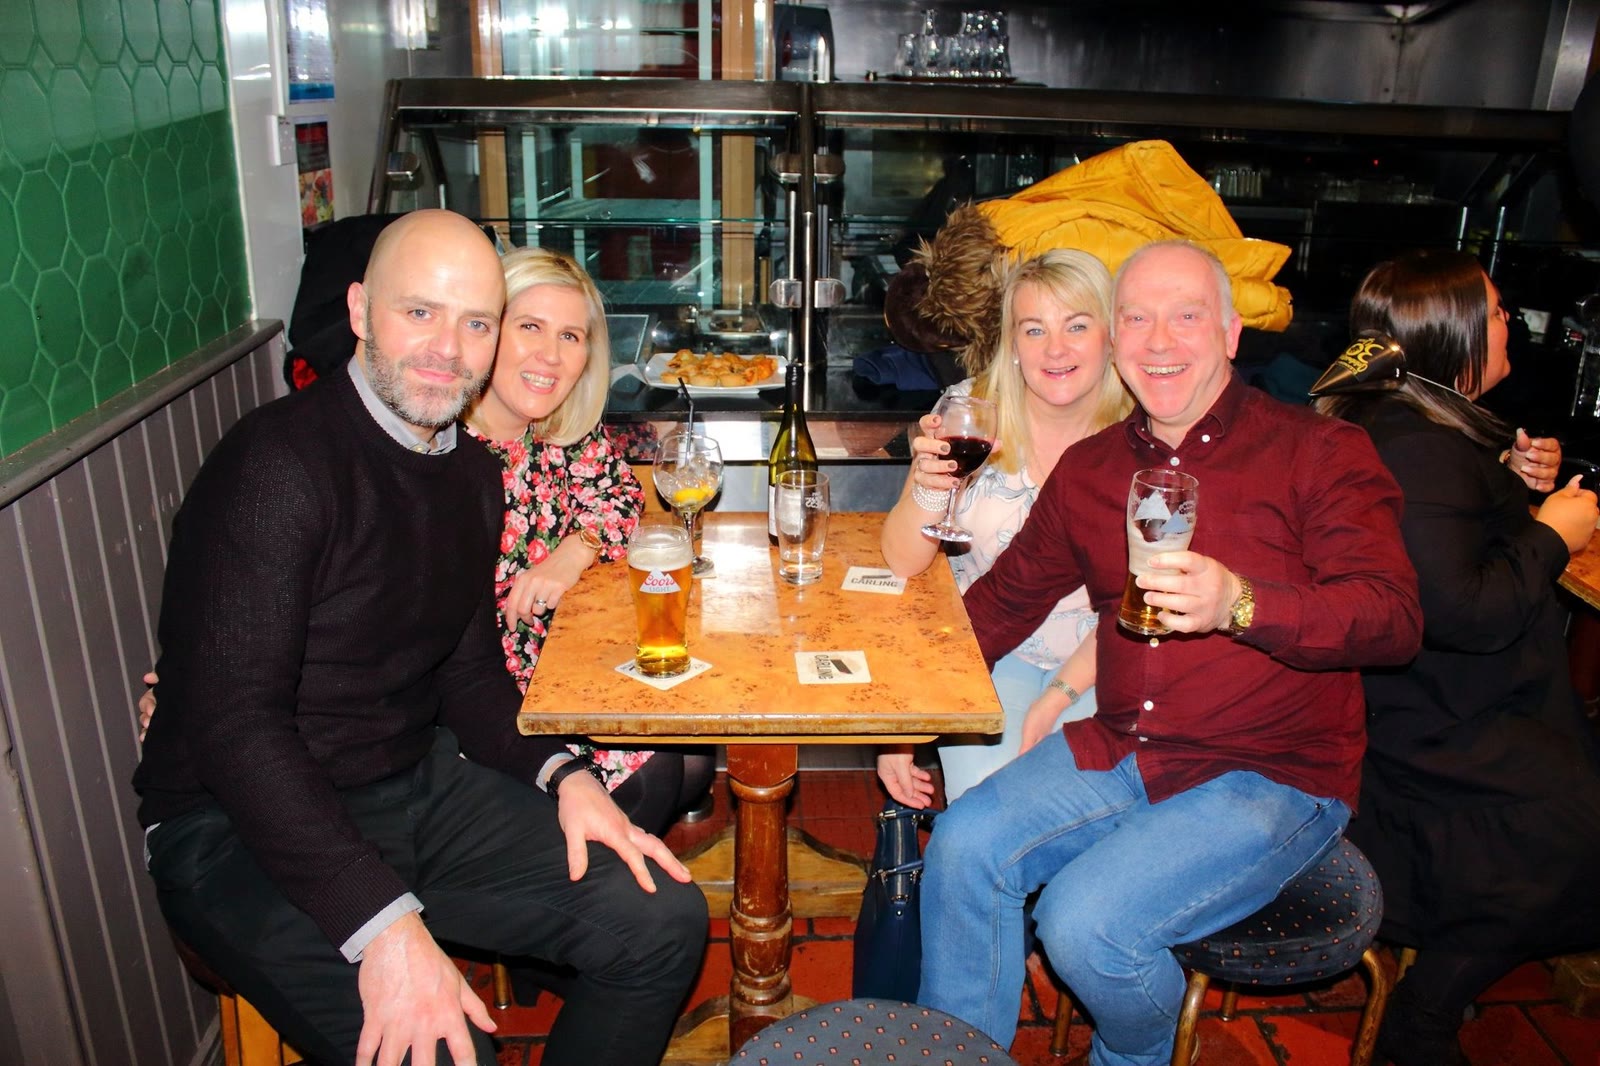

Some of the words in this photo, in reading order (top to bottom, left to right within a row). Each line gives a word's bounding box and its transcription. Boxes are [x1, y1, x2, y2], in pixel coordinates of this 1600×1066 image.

[644, 574, 676, 586] Coors
[851, 577, 898, 588] CARLING
[814, 654, 834, 679] CARLING
